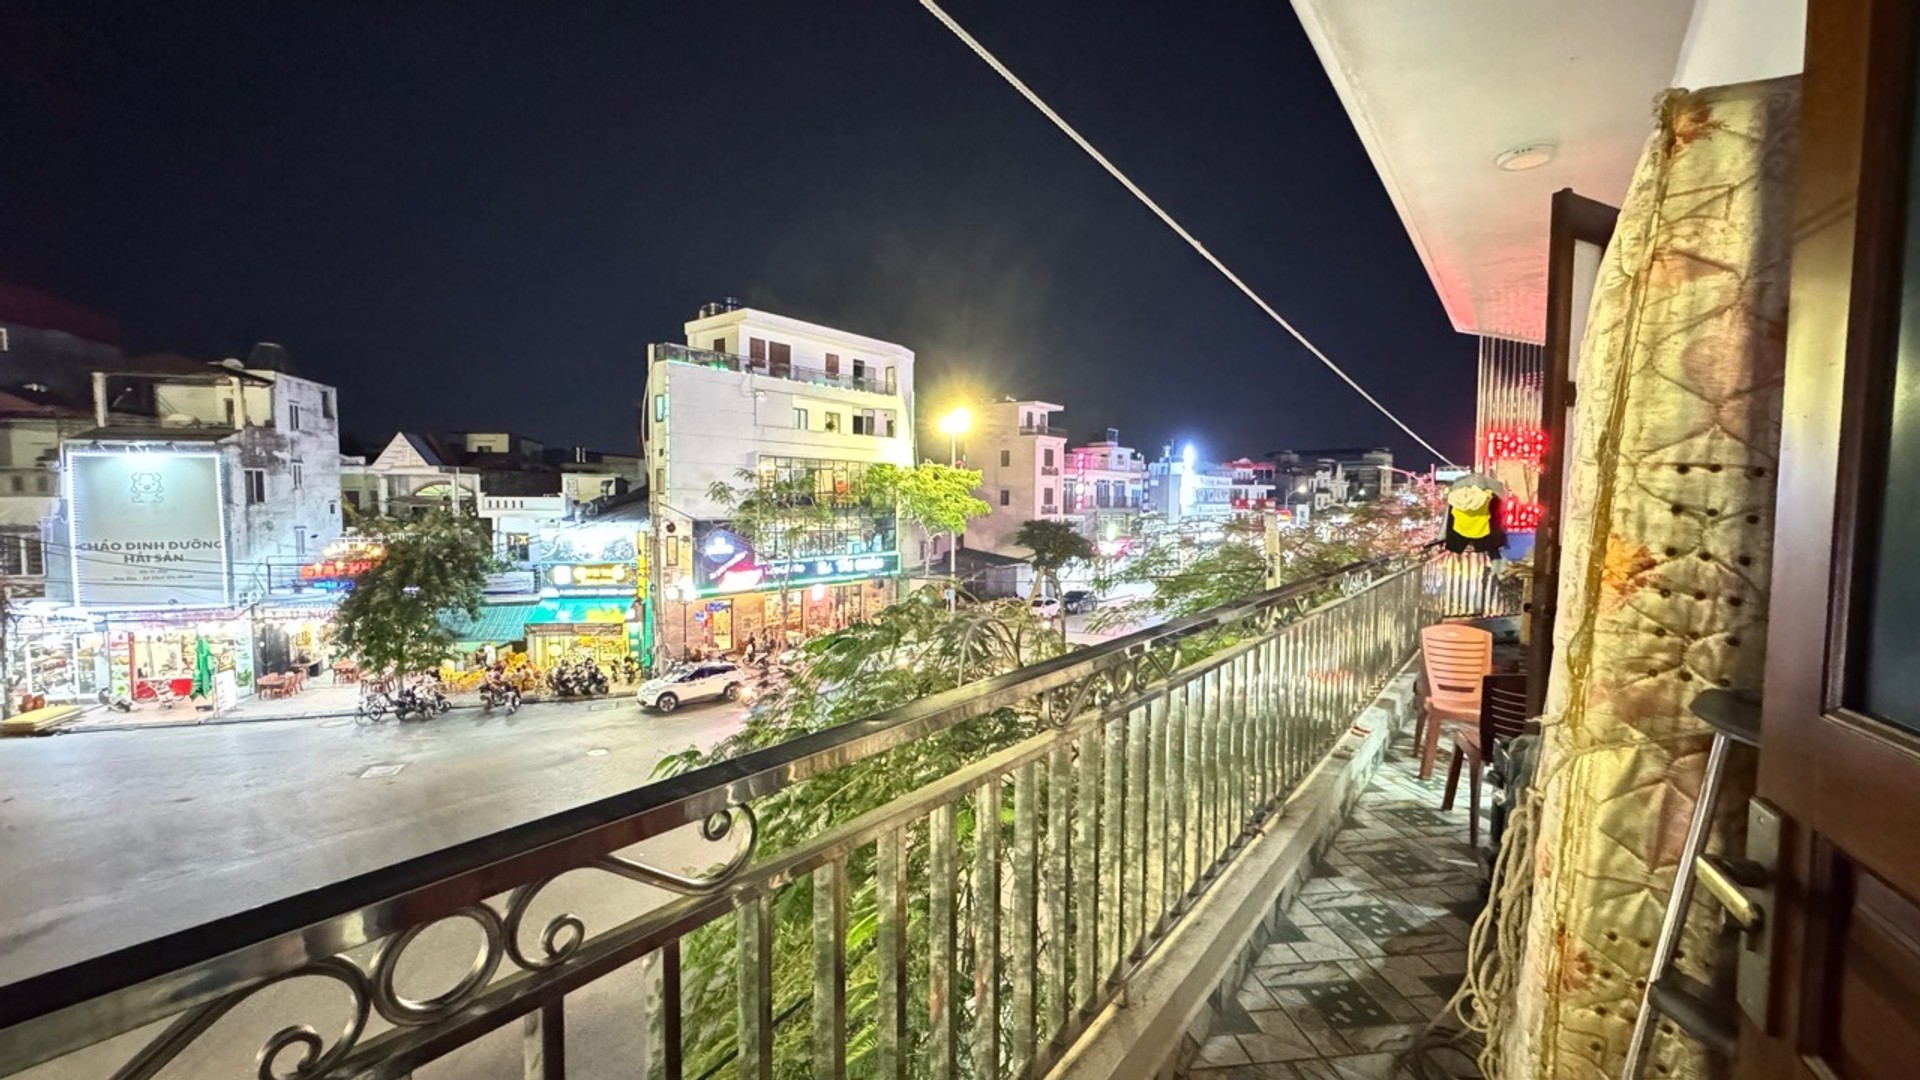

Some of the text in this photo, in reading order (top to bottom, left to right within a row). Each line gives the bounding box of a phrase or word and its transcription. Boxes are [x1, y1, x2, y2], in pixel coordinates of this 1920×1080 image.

[79, 538, 222, 551] CHÁO DINH DƯỠNG
[125, 551, 184, 563] HẢI SẢN
